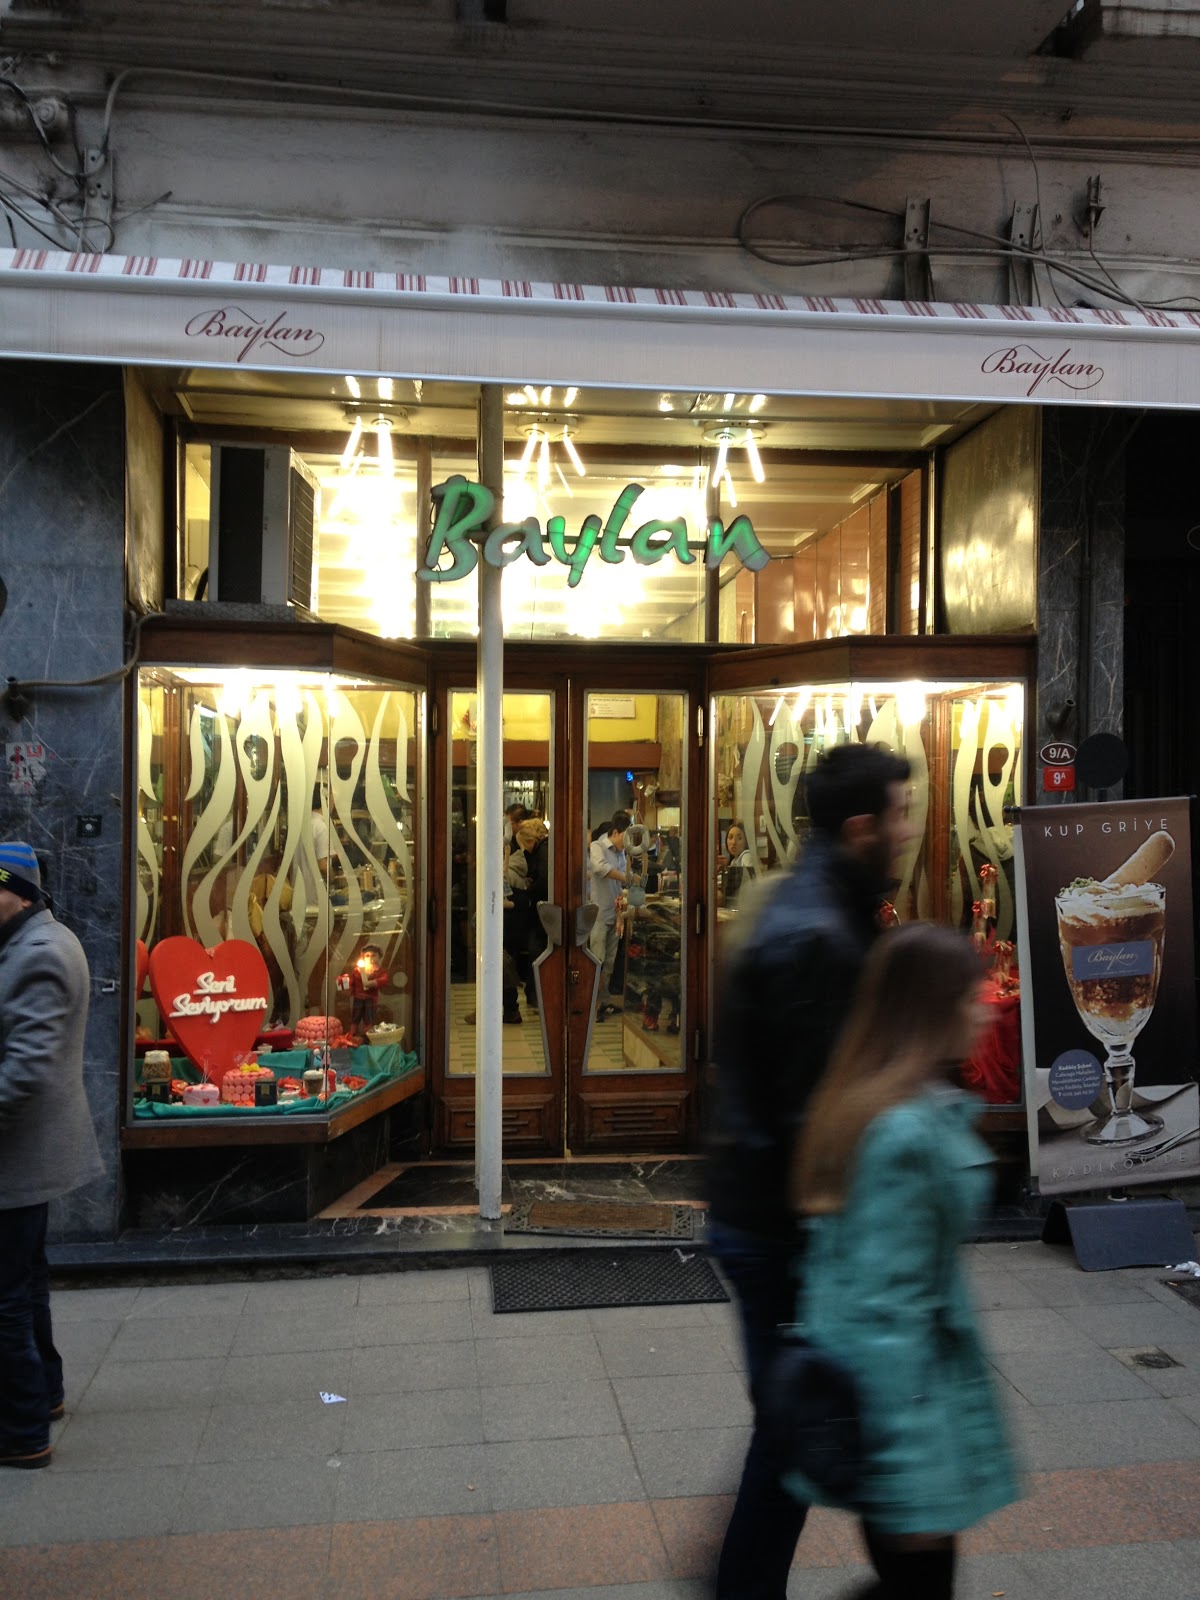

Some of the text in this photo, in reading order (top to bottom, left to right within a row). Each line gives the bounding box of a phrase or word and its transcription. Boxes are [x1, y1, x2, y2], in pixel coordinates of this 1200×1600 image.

[185, 306, 325, 363] Baylan
[981, 344, 1104, 397] Baylan
[415, 474, 772, 588] Baylan
[1049, 747, 1071, 759] 9/A
[1044, 824, 1084, 837] KUP
[1088, 948, 1138, 970] Baylan
[193, 971, 237, 995] Seni
[168, 993, 268, 1024] Seviyorum
